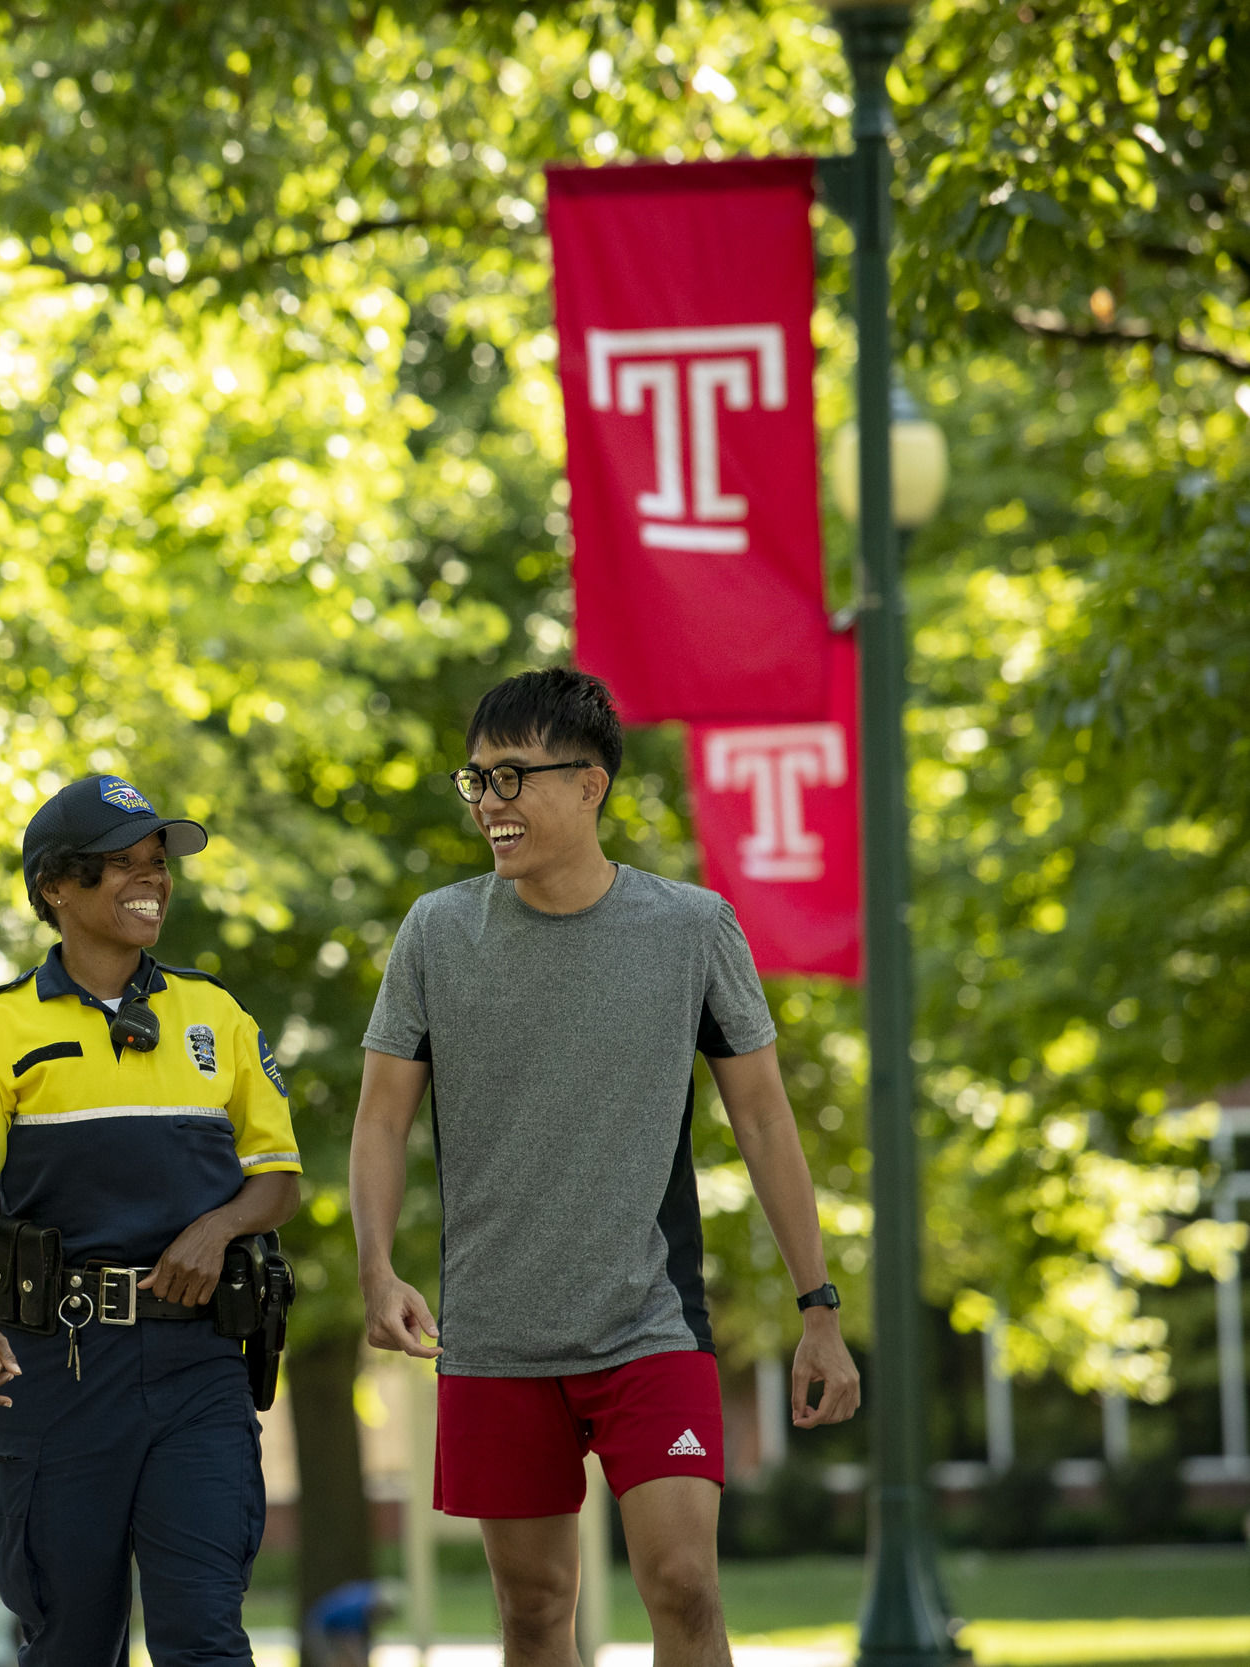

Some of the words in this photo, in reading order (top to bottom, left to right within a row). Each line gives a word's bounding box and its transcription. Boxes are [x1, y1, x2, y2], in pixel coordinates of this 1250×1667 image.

[586, 323, 787, 554] T
[705, 722, 848, 881] T
[667, 1446, 707, 1457] adidas
